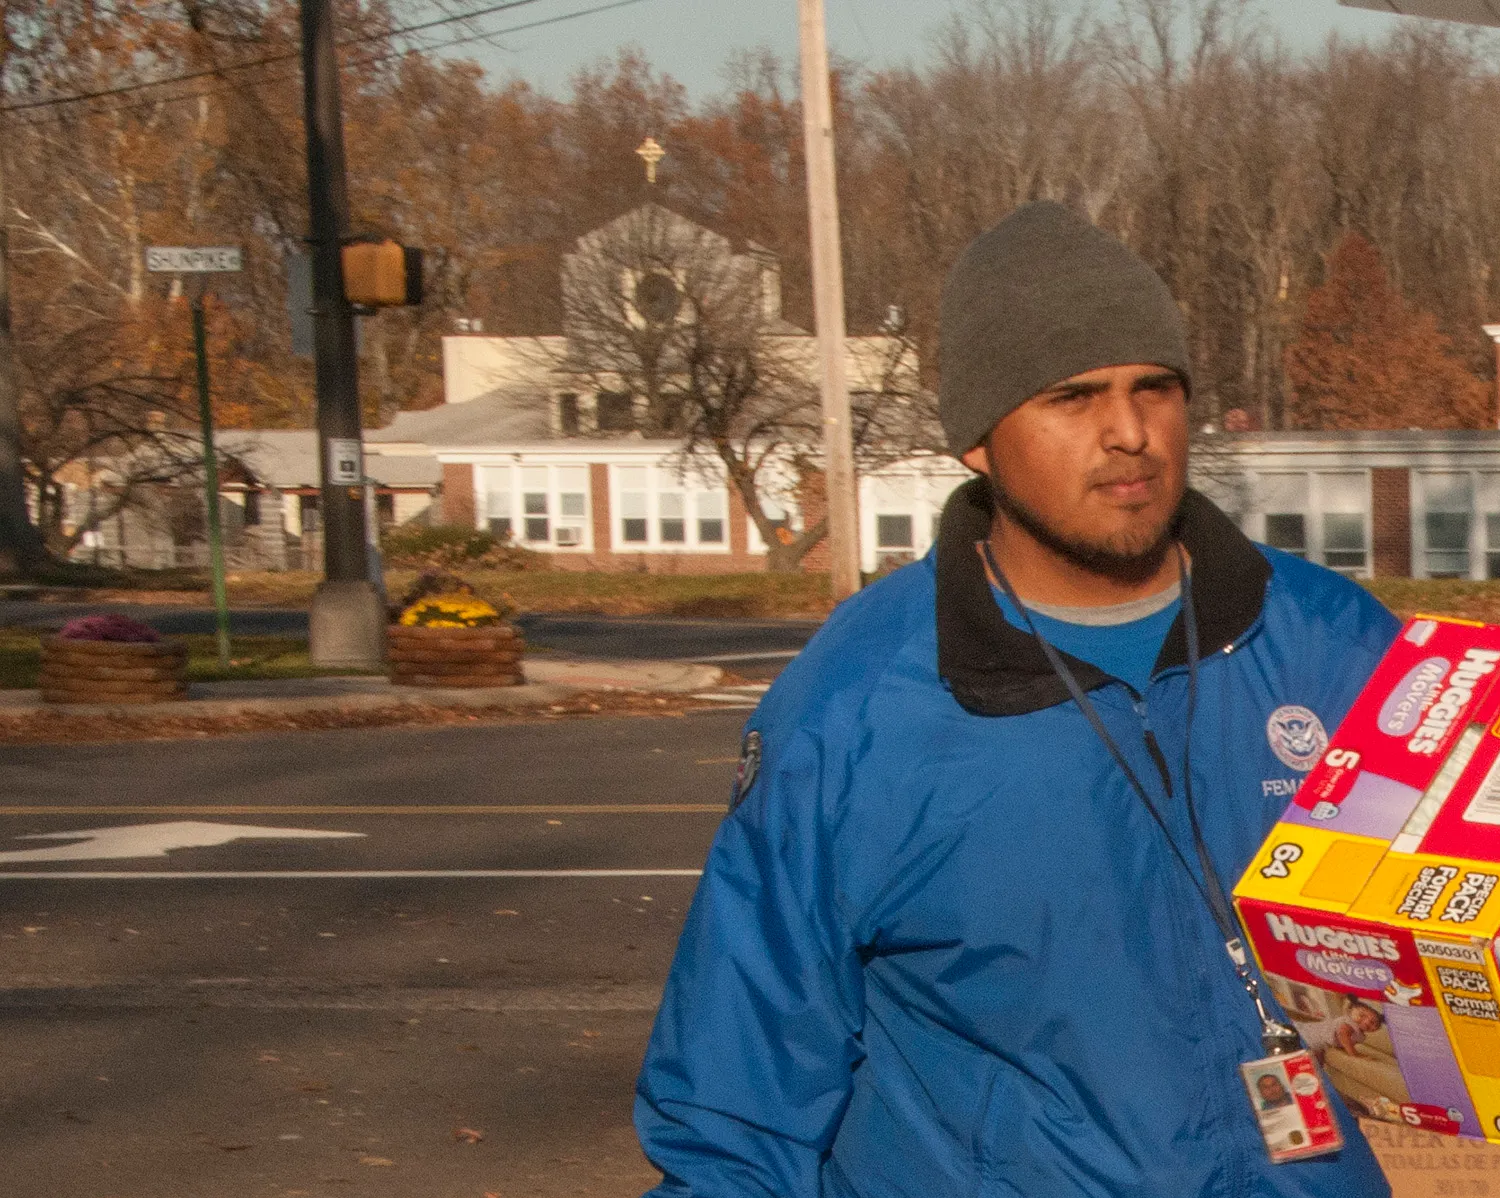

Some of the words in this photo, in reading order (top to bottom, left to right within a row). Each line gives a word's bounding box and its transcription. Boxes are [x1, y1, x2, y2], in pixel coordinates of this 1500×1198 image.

[1387, 662, 1443, 730] Movers
[1325, 749, 1361, 770] 5
[1261, 778, 1304, 797] FEM
[1260, 842, 1304, 879] 64
[1408, 865, 1460, 921] Format
[1439, 872, 1486, 923] PACK
[1461, 874, 1499, 923] SPECIAL
[1264, 911, 1401, 962] HUGGIES
[1418, 942, 1480, 961] 3050301
[1306, 952, 1389, 982] Movers
[1437, 966, 1486, 981] SPECIAL
[1441, 975, 1491, 994] PACK
[1443, 992, 1500, 1011] Format
[1401, 1106, 1422, 1126] 5
